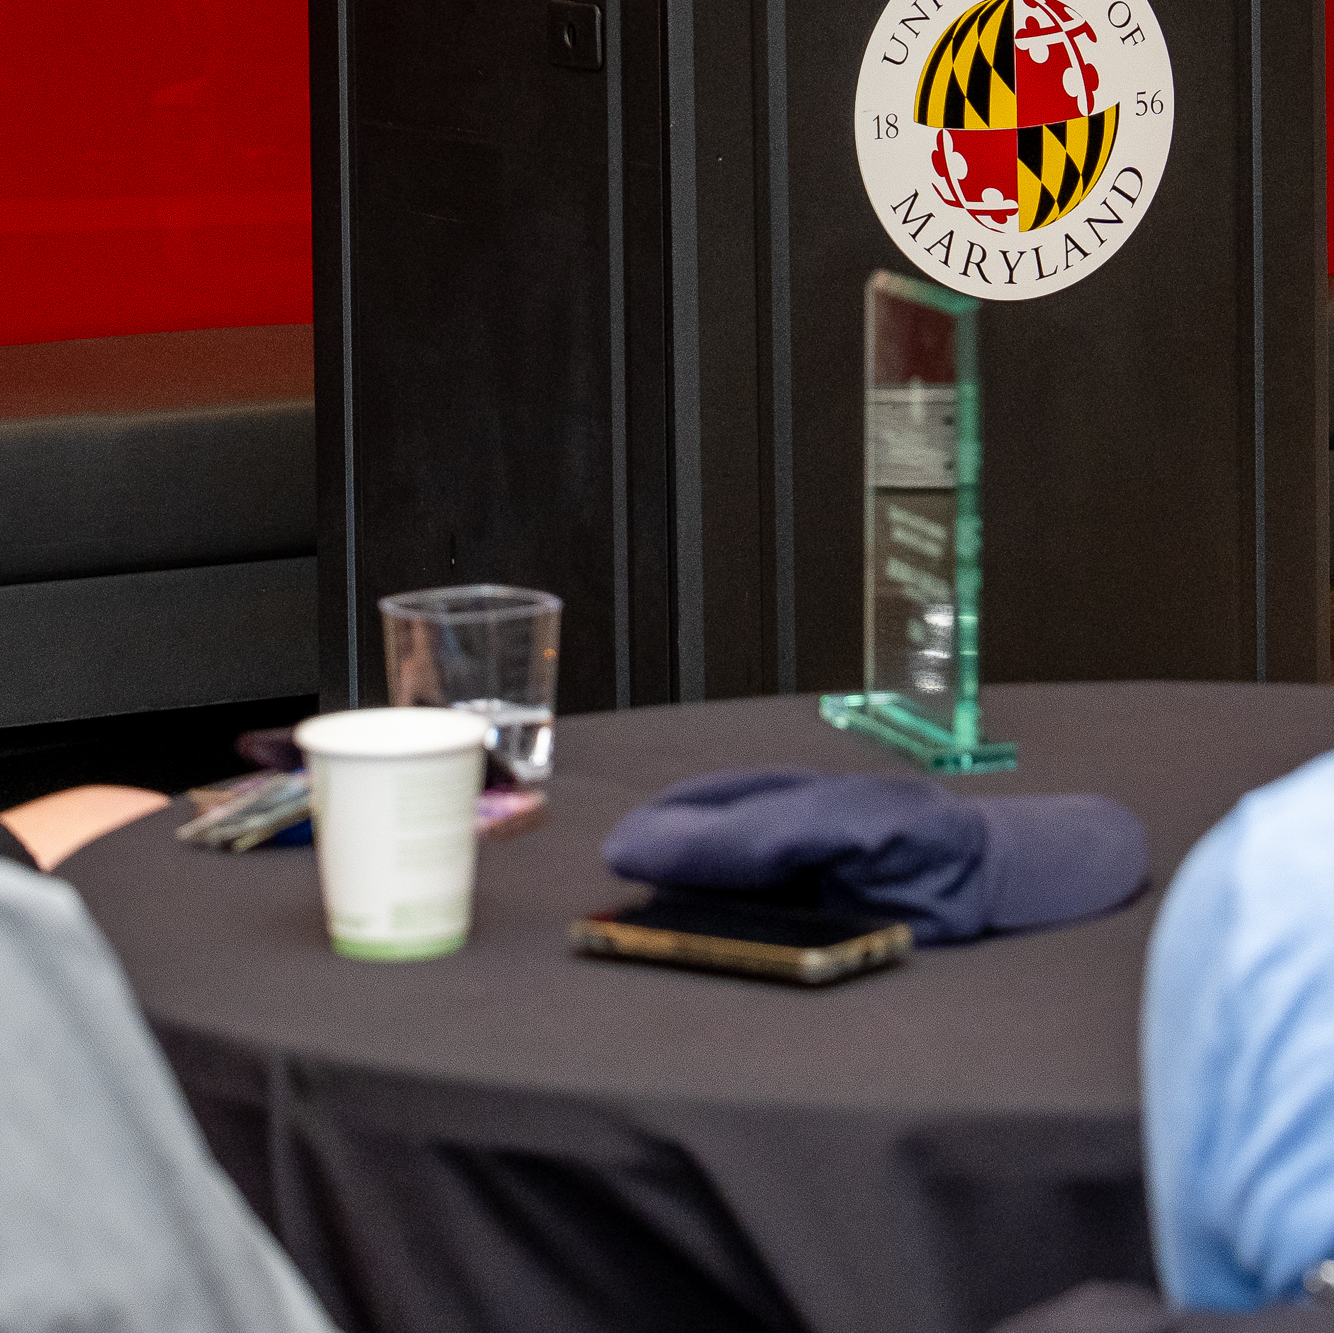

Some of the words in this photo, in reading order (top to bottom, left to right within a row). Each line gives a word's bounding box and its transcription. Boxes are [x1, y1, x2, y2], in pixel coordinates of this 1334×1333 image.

[1107, 0, 1146, 47] OF
[871, 113, 900, 140] 18
[1135, 90, 1165, 117] 56
[890, 166, 1144, 285] MARYLAND
